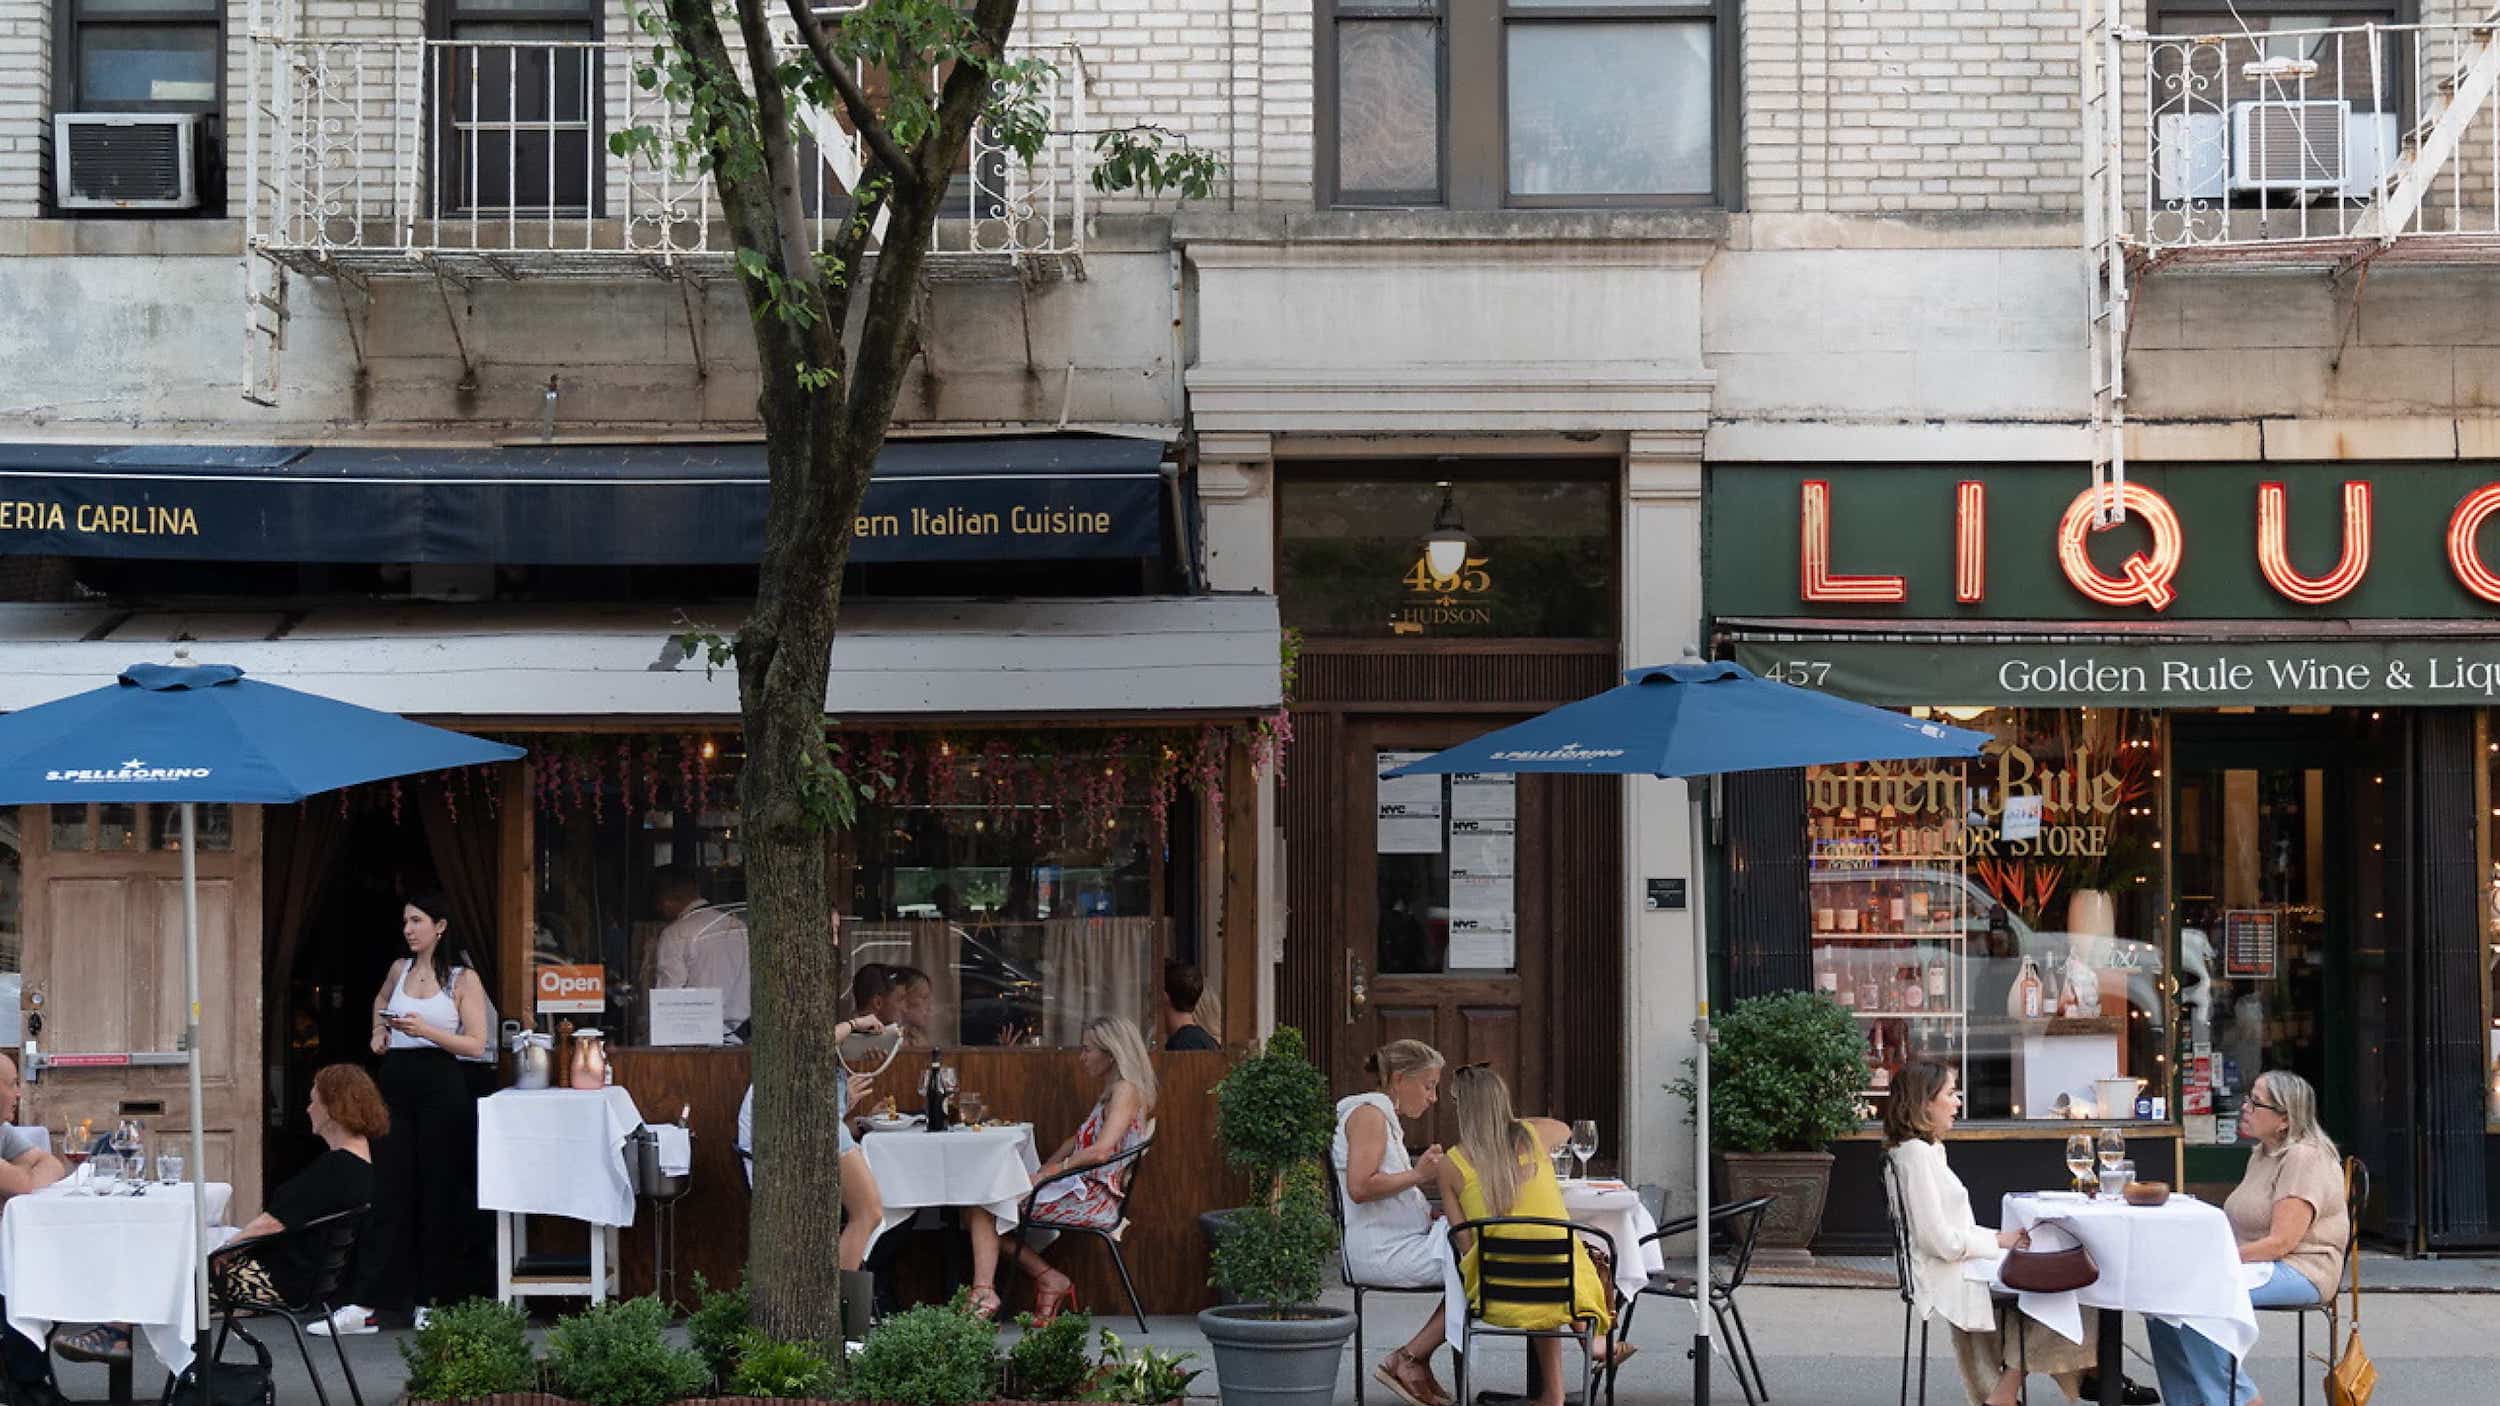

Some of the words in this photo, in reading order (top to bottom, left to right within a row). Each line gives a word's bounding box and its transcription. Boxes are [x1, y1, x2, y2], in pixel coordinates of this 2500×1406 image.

[0, 502, 66, 530] ERIA
[77, 504, 199, 535] CARLINA
[853, 514, 899, 537] ern
[911, 506, 999, 536] Italian
[1011, 505, 1111, 534] Cuisine
[1402, 607, 1491, 624] HUDSON
[1764, 661, 1832, 686] 457
[1998, 659, 2146, 692] Golden
[2161, 658, 2253, 691] Rule
[2266, 658, 2371, 690] Wine
[2385, 659, 2415, 690] &
[45, 767, 211, 781] S.PELLEGRINO
[1806, 760, 1959, 815] olden
[1979, 744, 2122, 816] Rule
[1380, 804, 1406, 814] NYC
[1452, 821, 1479, 830] NYC
[2010, 825, 2108, 857] STORE
[1452, 919, 1479, 928] NYC
[541, 972, 601, 997] Open
